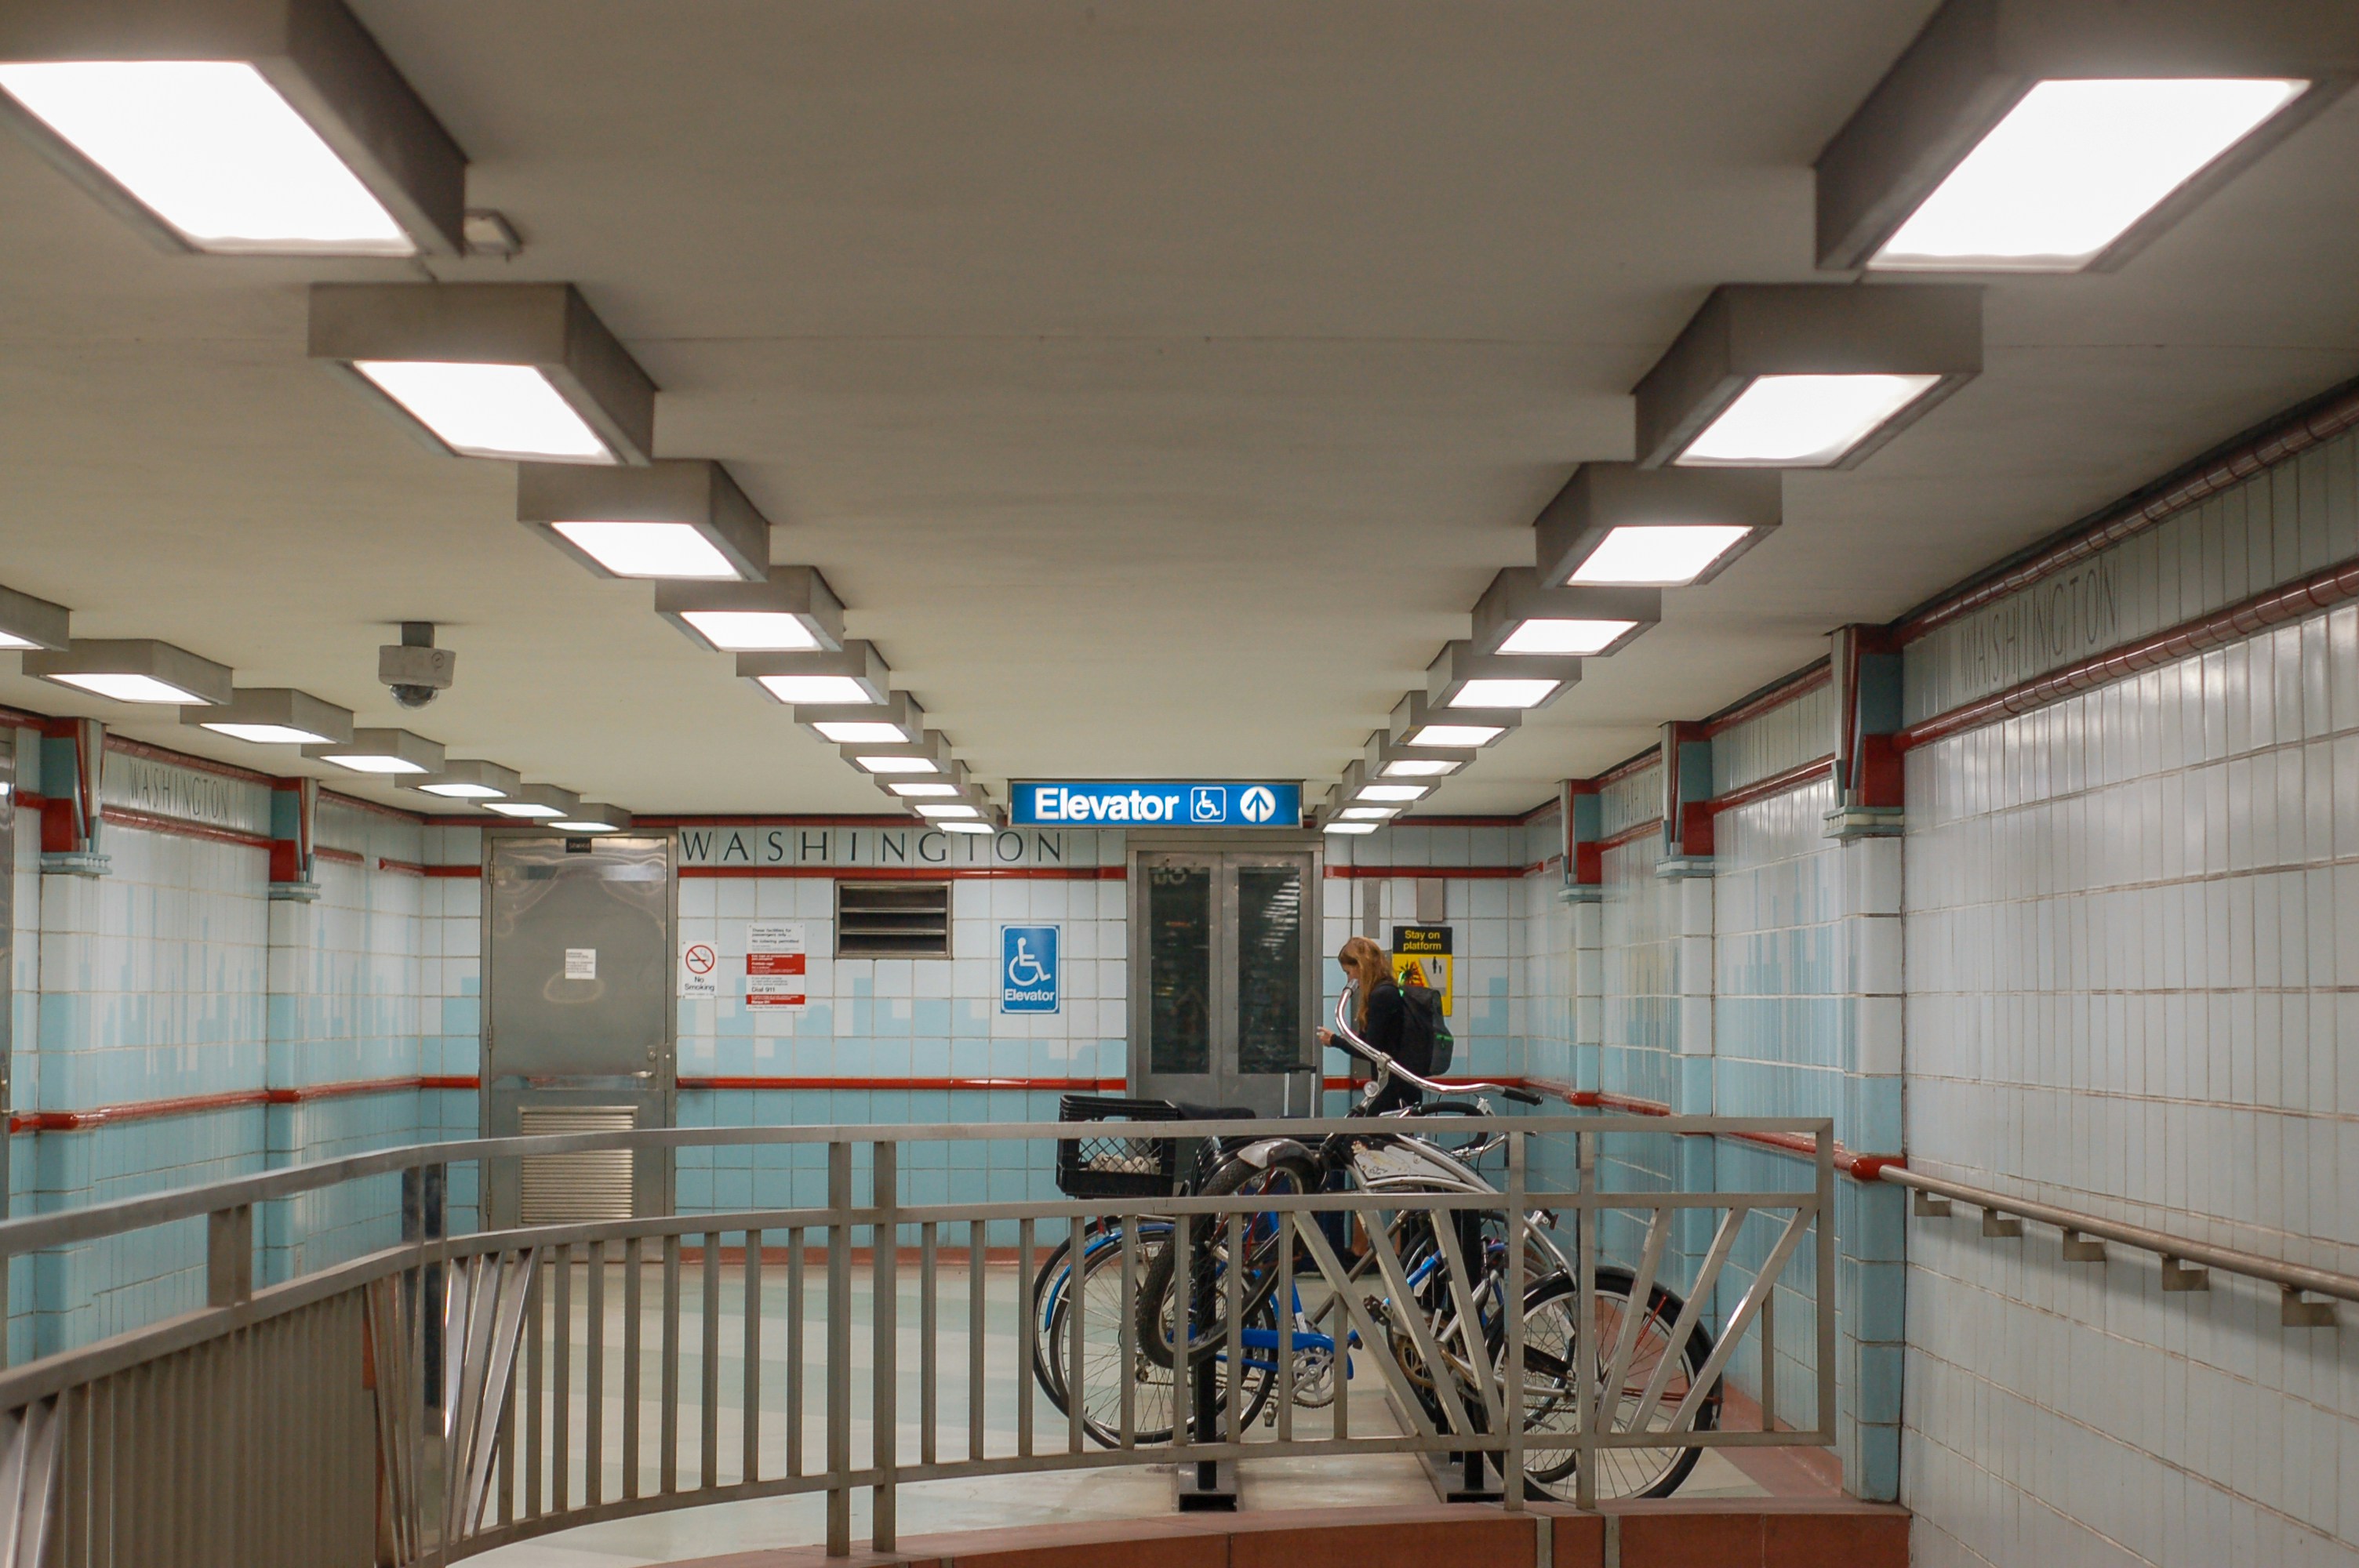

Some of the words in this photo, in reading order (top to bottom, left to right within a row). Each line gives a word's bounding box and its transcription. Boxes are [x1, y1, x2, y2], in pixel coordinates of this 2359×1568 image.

[1961, 559, 2116, 691] WASHINGTON
[130, 762, 227, 820] WASHINGTON
[1034, 787, 1180, 821] Elevator
[682, 830, 1060, 862] WASHINGTON
[1403, 941, 1442, 952] platform
[1405, 930, 1425, 941] Stay
[685, 983, 715, 992] Smoking
[1005, 988, 1056, 1002] Elevator
